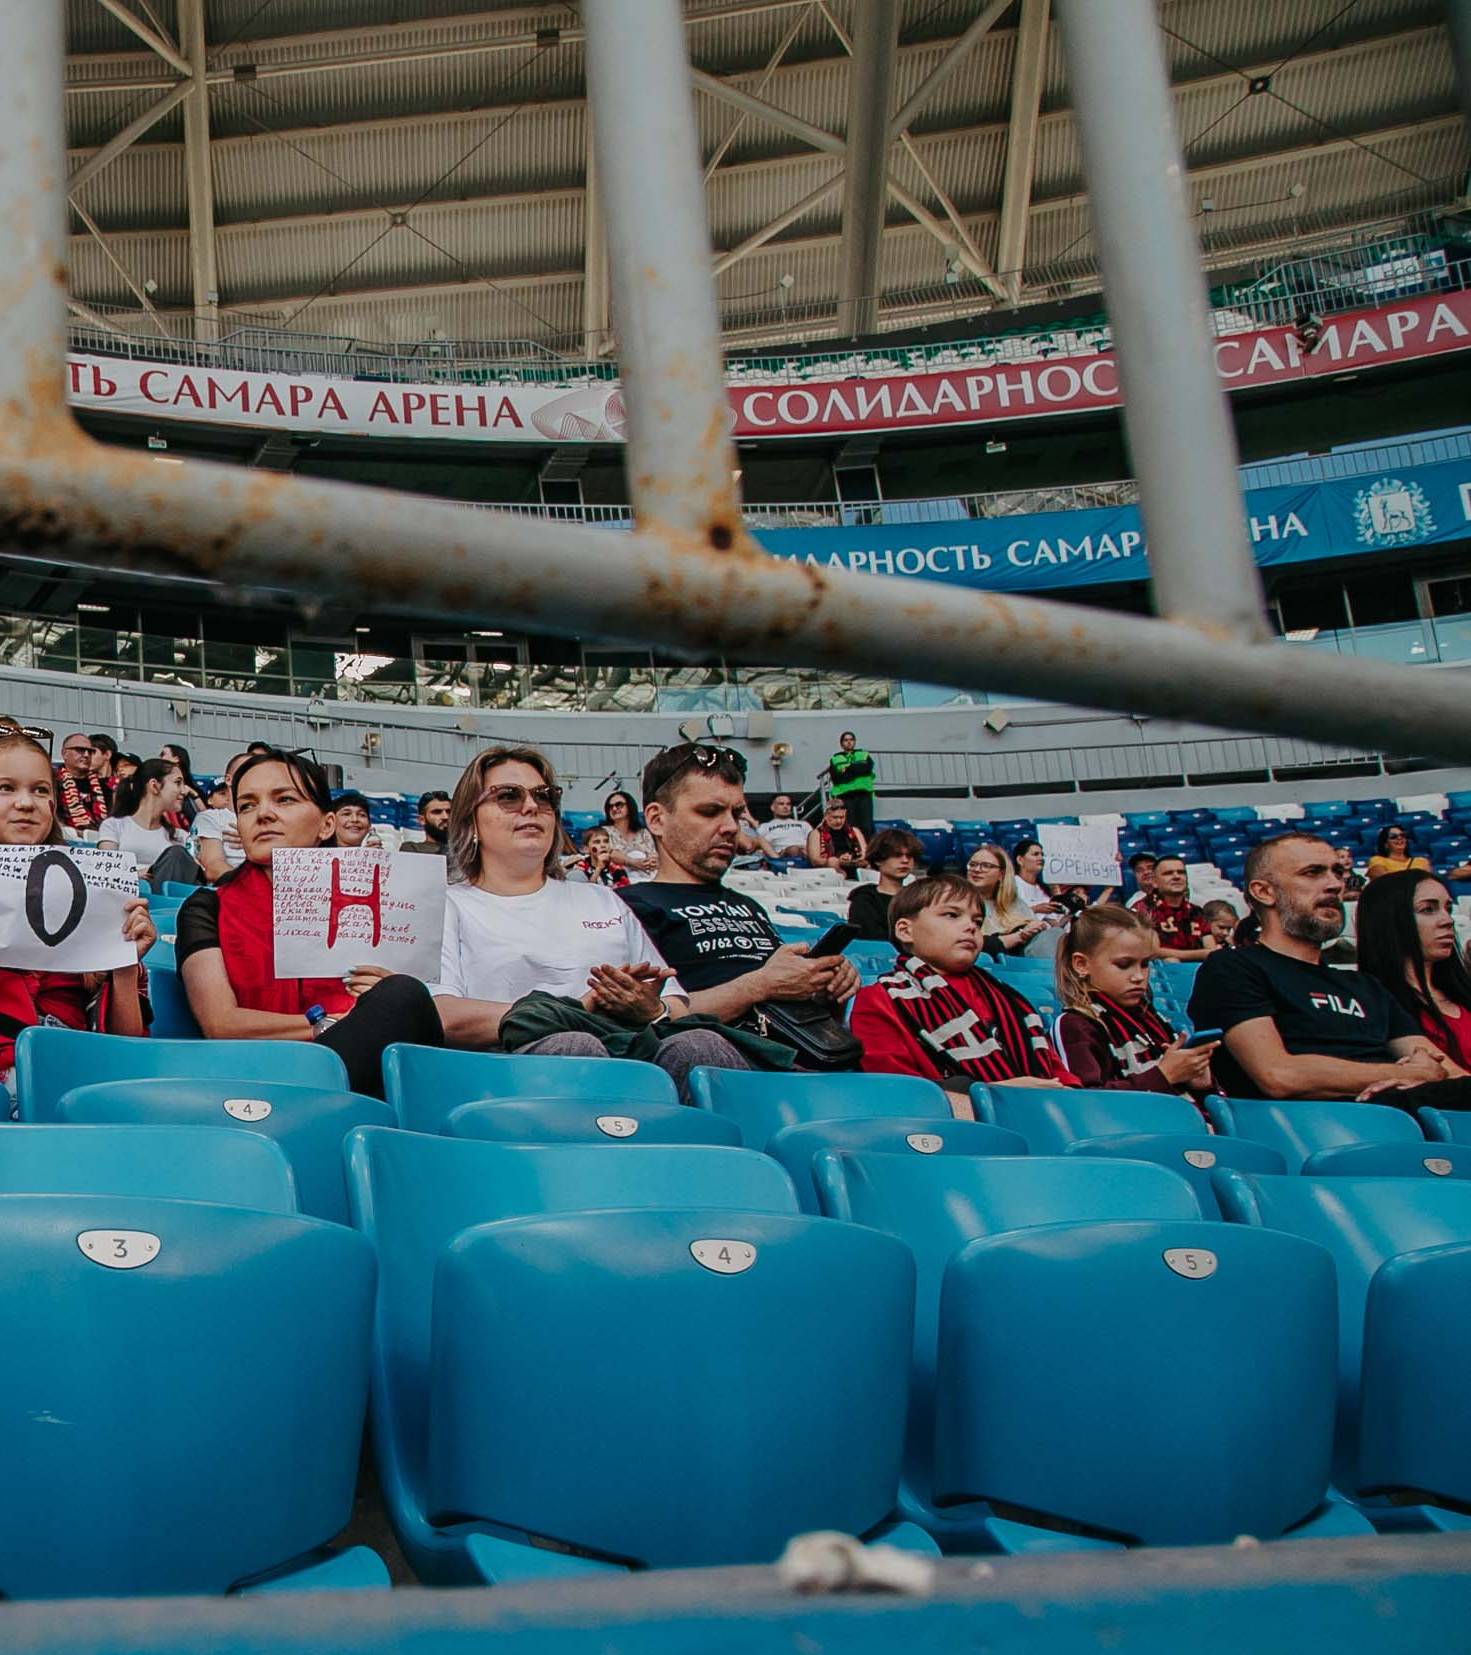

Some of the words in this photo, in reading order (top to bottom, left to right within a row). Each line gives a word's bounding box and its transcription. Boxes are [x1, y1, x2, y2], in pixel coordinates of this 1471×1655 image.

[139, 370, 349, 420] САМАРА
[369, 391, 523, 428] АРЕНА
[743, 359, 1120, 426] СОЛИДАРНОС
[1007, 531, 1160, 568] САМАР
[327, 858, 380, 949] Н
[1309, 992, 1365, 1018] FILA
[243, 1104, 253, 1116] 4
[615, 1121, 623, 1131] 5
[113, 1239, 128, 1258] 3
[718, 1247, 732, 1265] 4
[1186, 1255, 1197, 1271] 5
